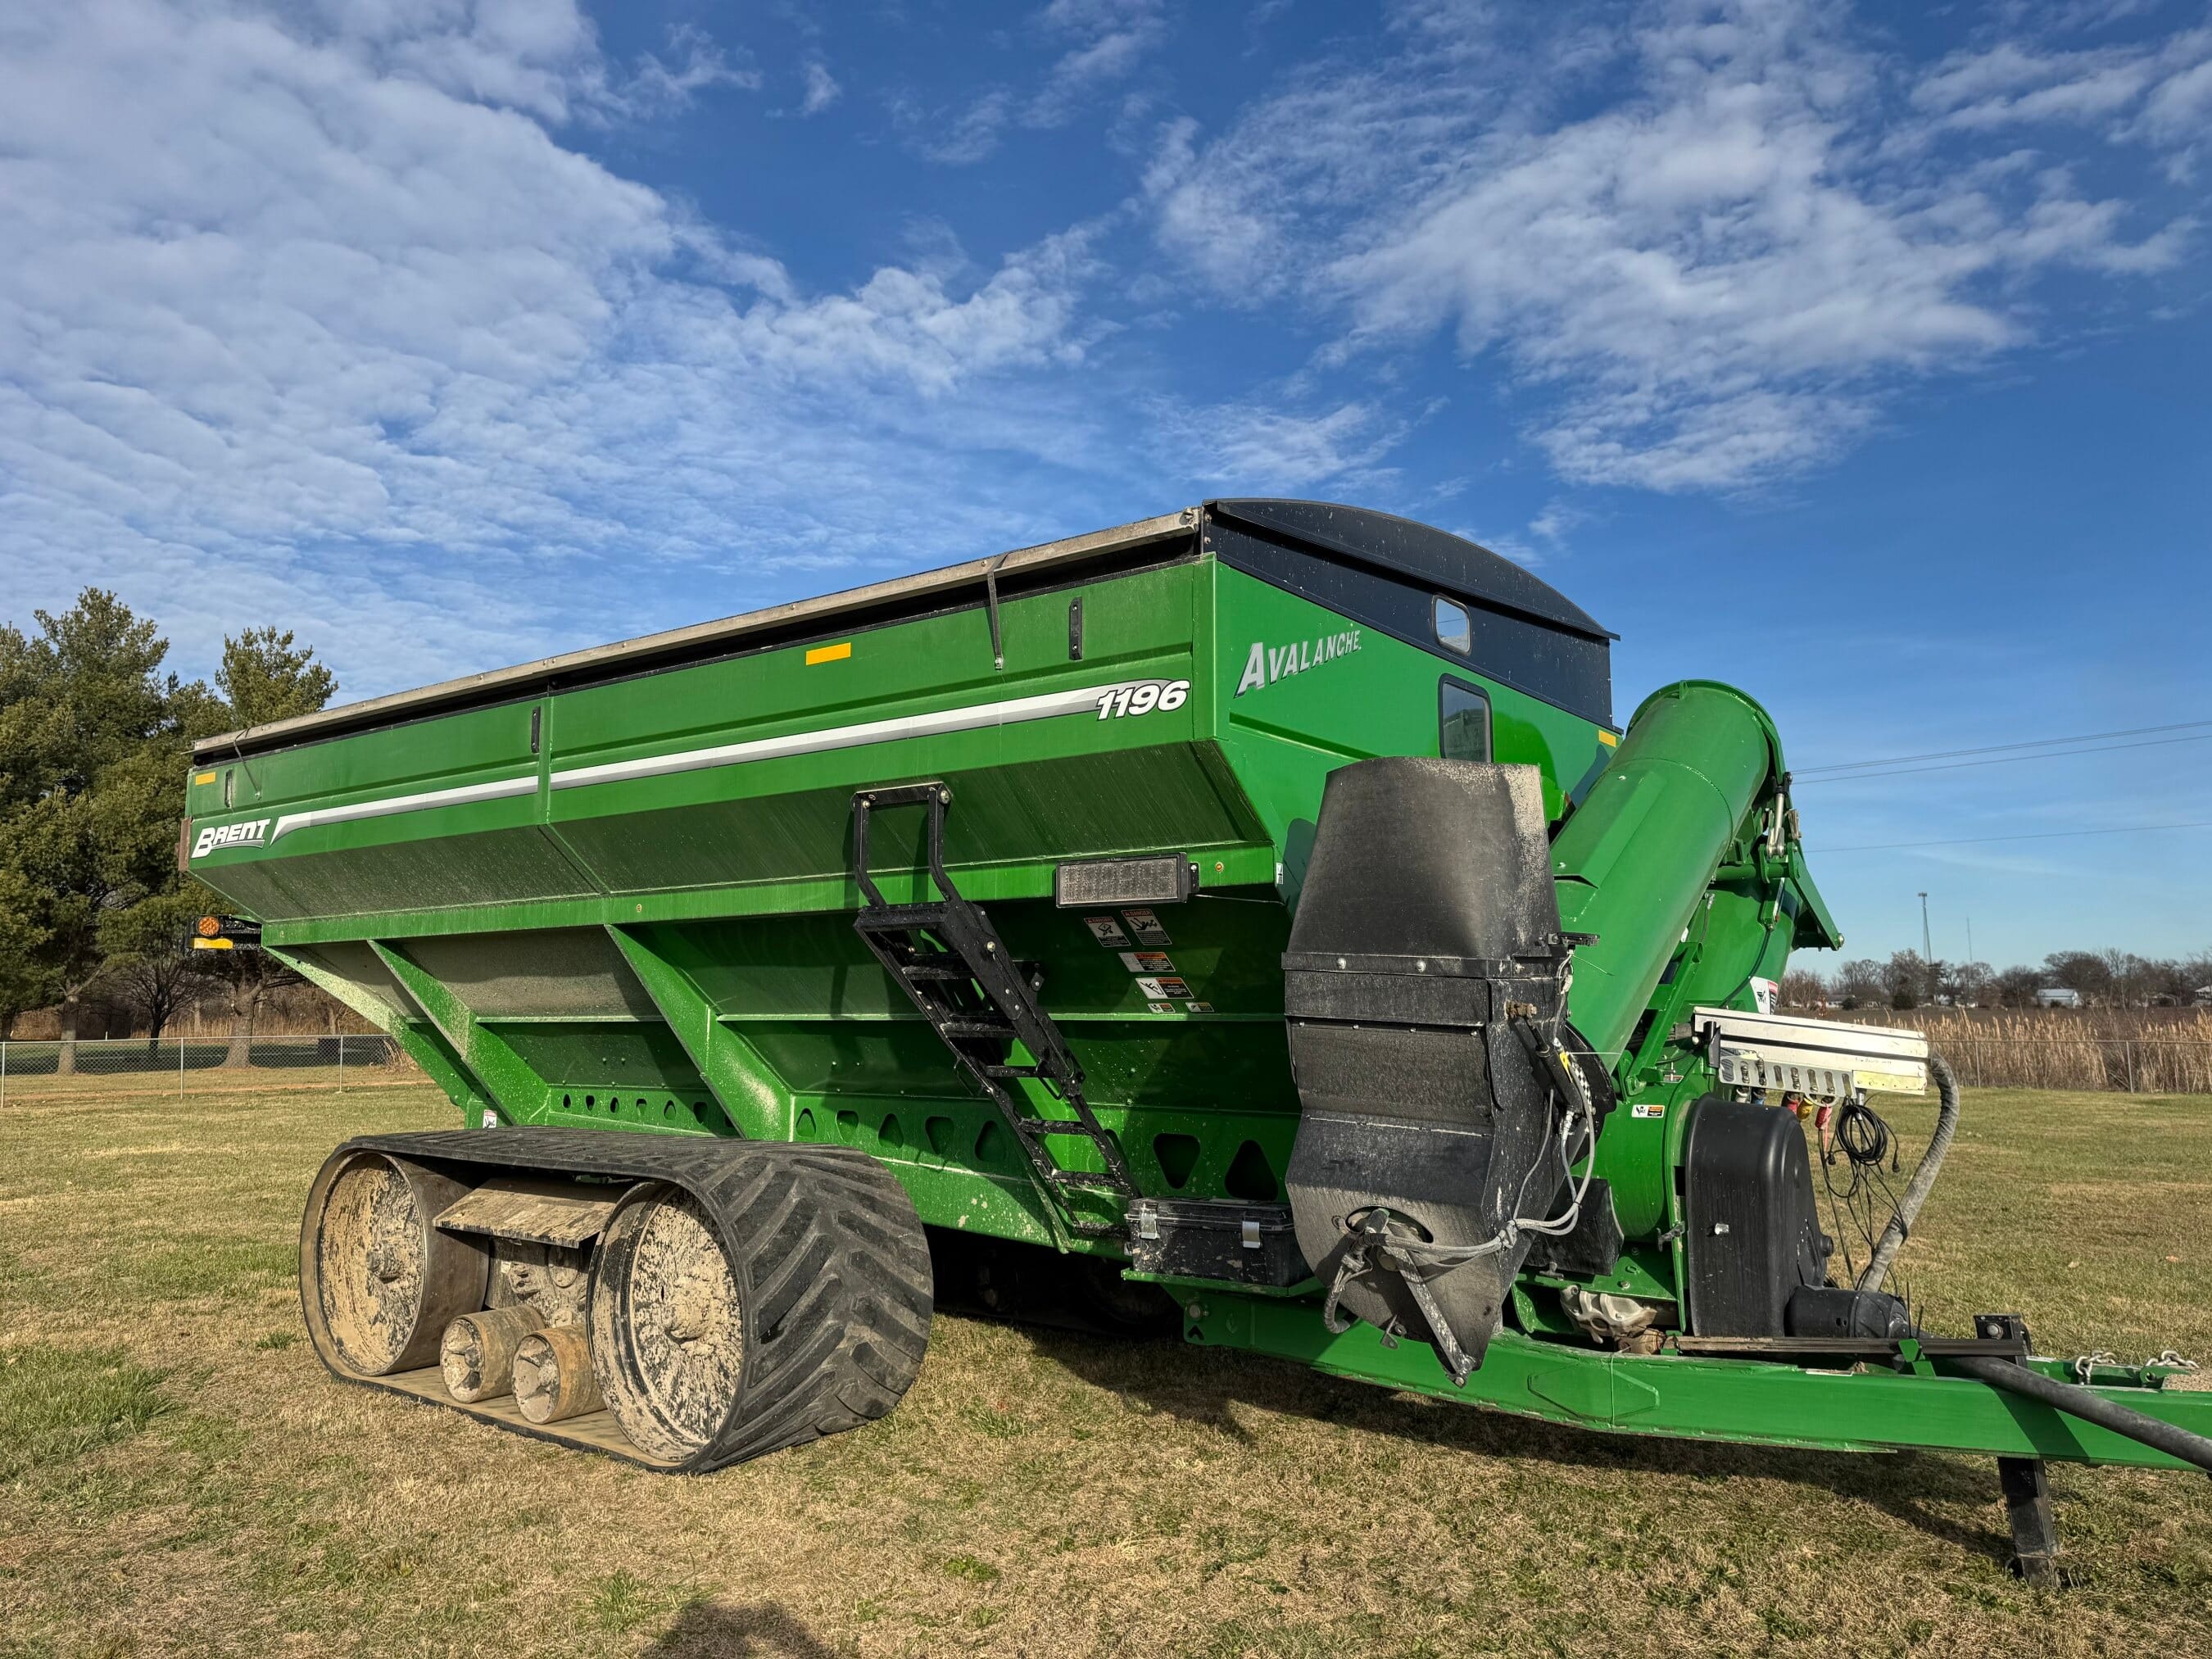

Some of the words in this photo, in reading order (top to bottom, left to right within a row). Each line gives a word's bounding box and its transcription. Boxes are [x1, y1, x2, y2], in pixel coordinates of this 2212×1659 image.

[1234, 630, 1362, 699] AVALANCHE
[1096, 679, 1191, 721] 1196
[191, 818, 272, 859] BRENT
